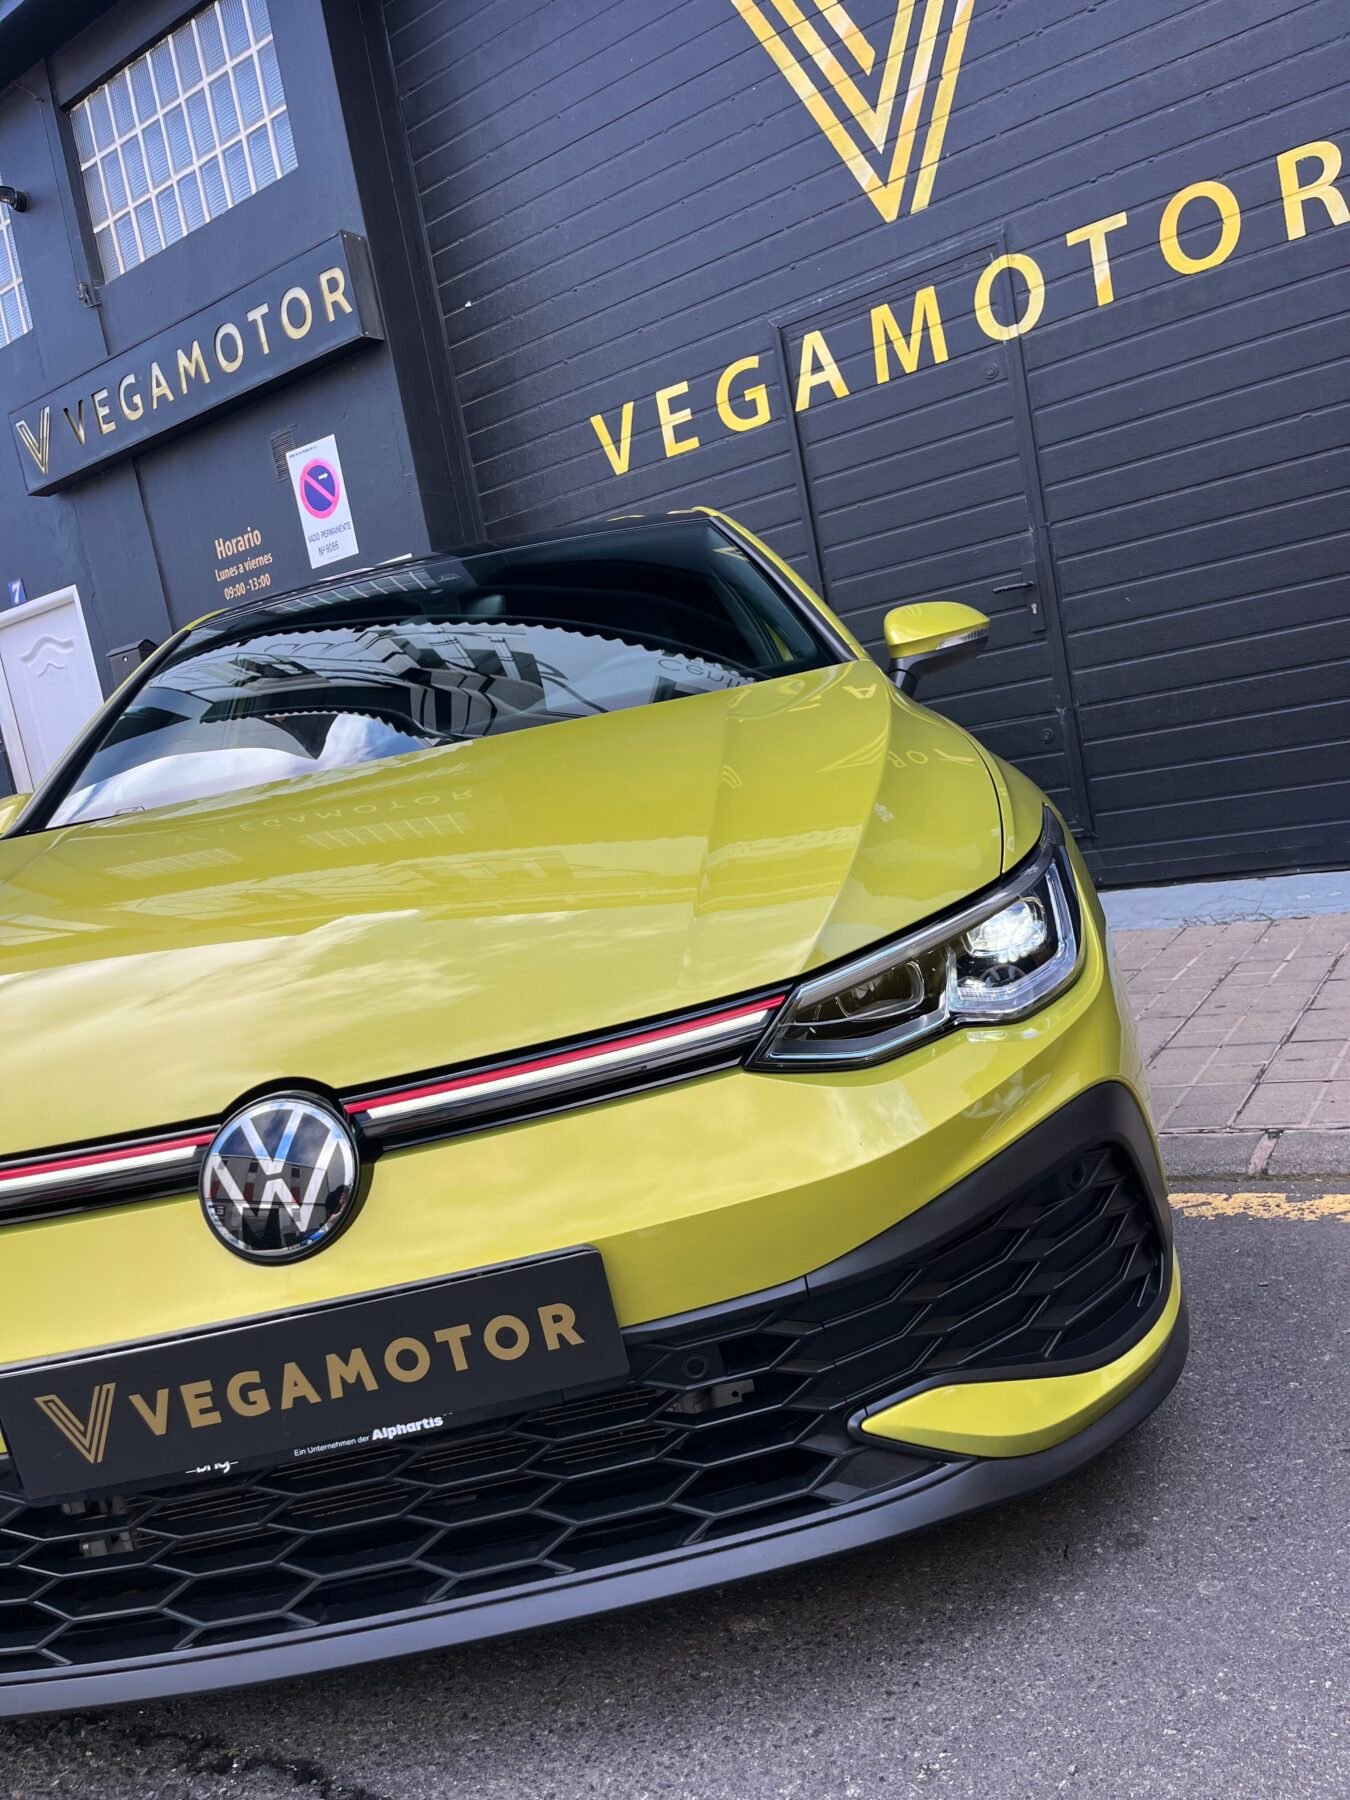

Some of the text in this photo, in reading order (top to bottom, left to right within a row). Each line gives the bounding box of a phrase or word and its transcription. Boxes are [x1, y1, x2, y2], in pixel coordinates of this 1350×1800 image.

[590, 141, 1350, 475] VEGAMOTOR
[63, 267, 353, 445] VEGAMOTOR
[214, 526, 262, 560] Horario
[215, 553, 273, 582] Lunes a viernes
[12, 581, 21, 604] 7
[224, 582, 246, 600] 09:00
[129, 1302, 585, 1436] VEGAMOTOR
[294, 1415, 443, 1457] Ein Unternehmen der Alphartis
